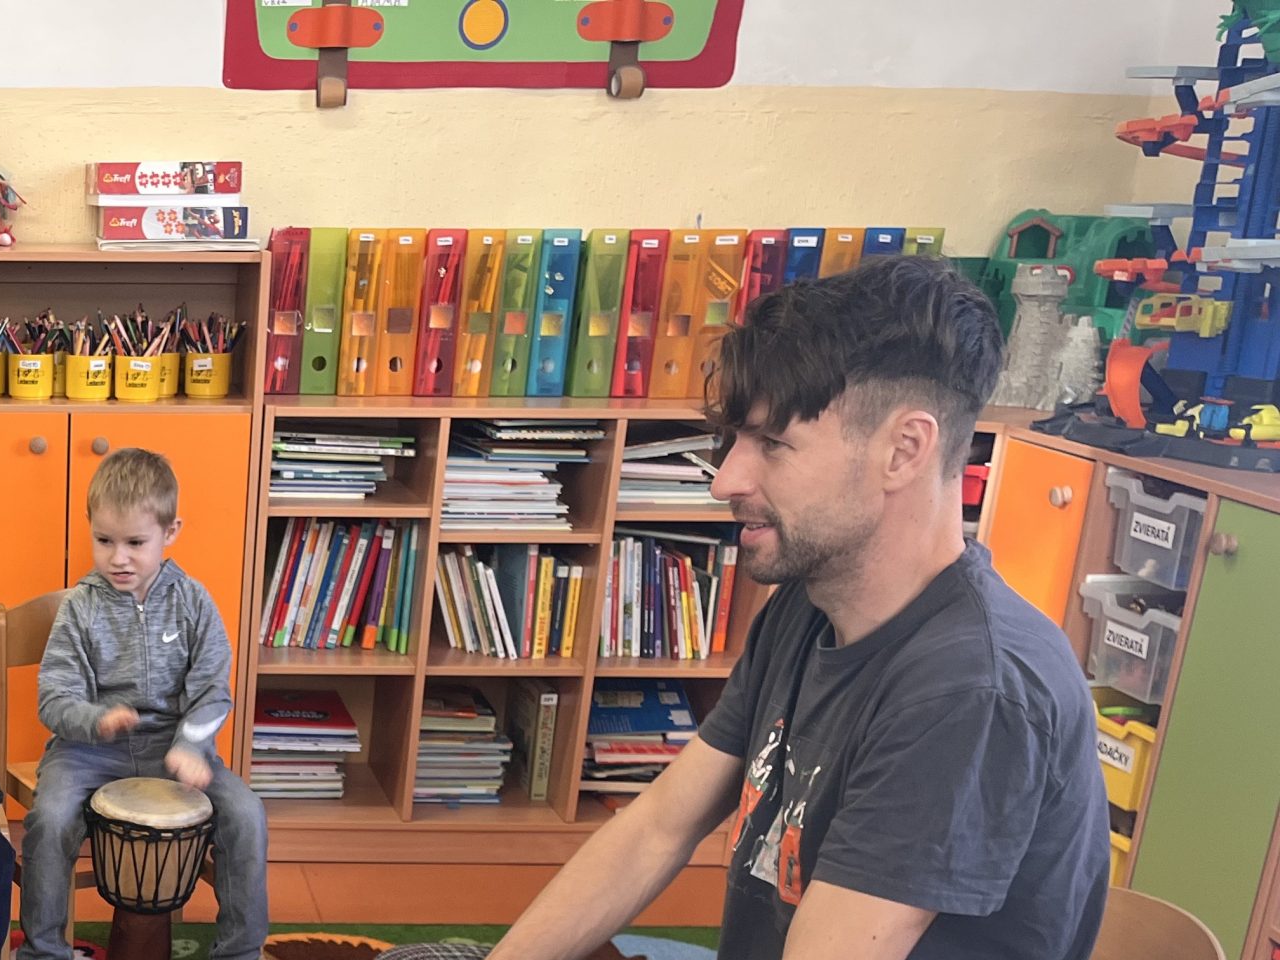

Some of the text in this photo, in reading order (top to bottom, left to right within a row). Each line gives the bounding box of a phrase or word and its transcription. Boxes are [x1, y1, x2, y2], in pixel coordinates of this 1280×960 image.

[112, 173, 132, 184] Trefl
[119, 217, 138, 228] Trefl
[1133, 520, 1171, 543] ZVIERATÁ
[1106, 630, 1144, 655] ZVIERATÁ
